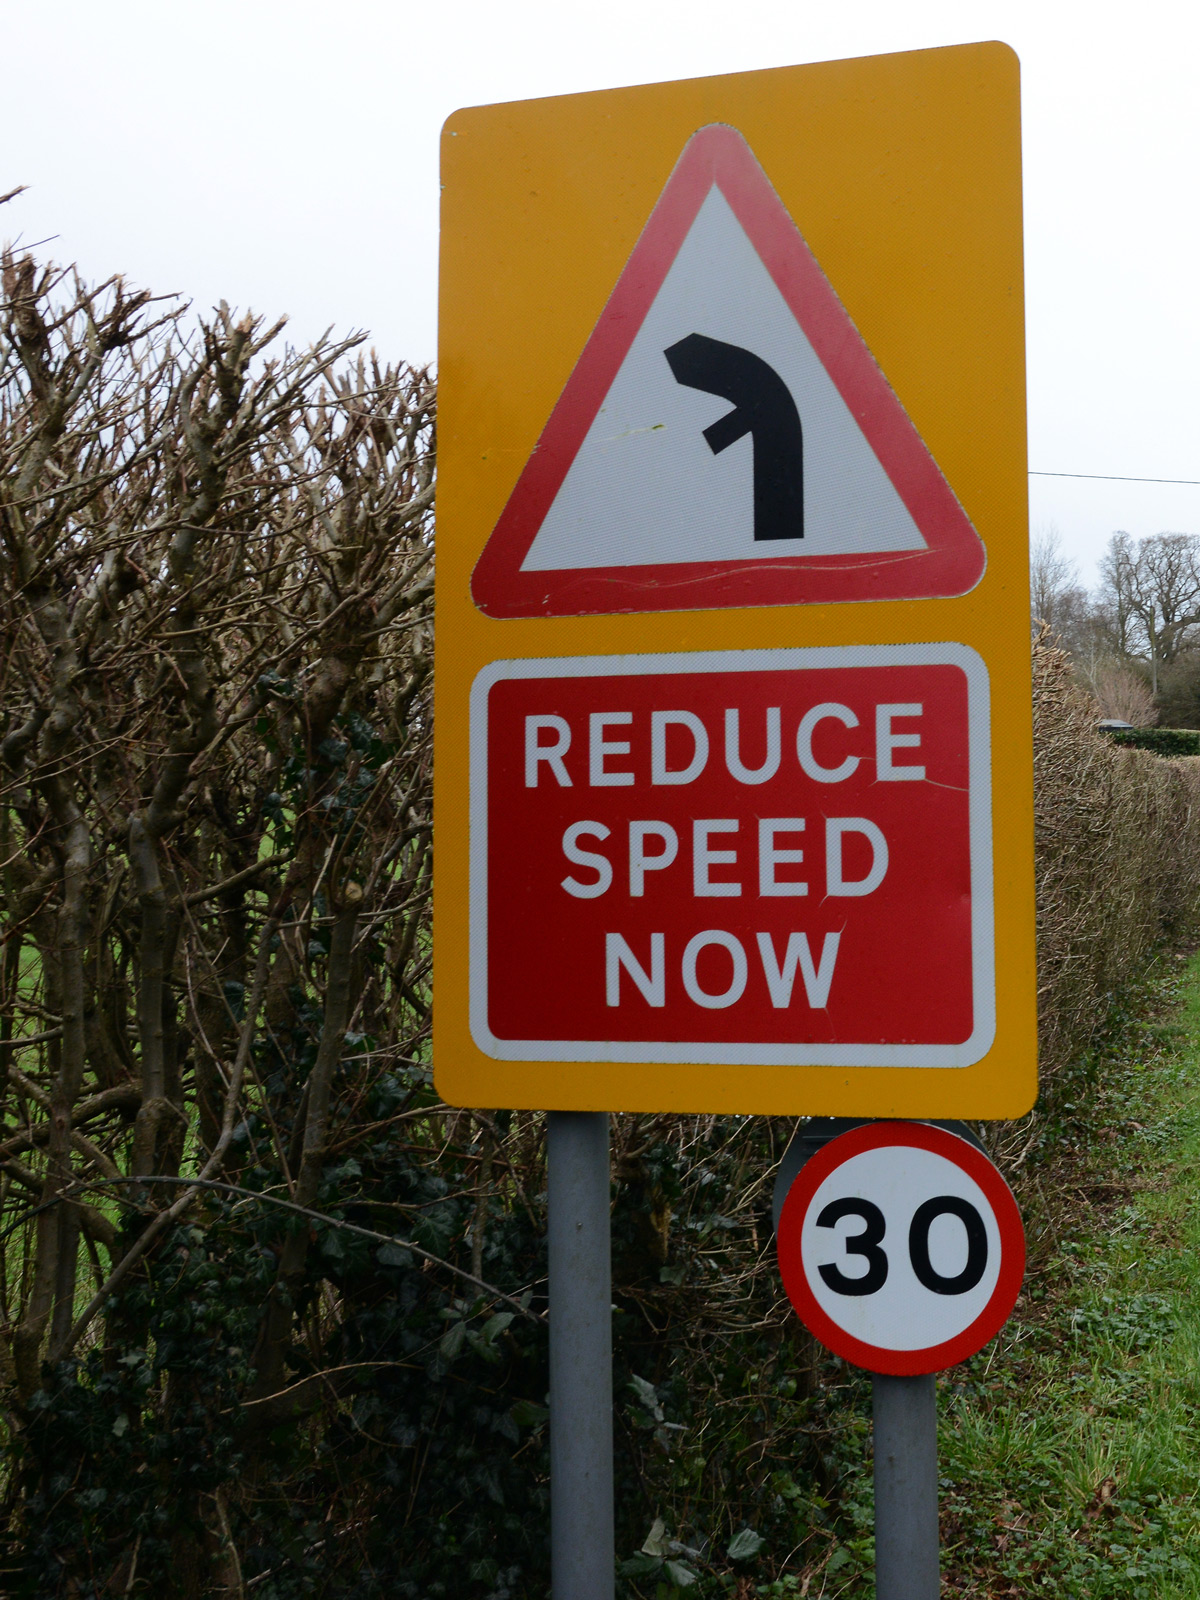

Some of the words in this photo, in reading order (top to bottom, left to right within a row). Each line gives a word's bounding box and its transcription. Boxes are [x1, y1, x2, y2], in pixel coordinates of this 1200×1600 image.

[525, 703, 927, 788] REDUCE
[561, 816, 890, 899] SPEED
[606, 929, 842, 1009] NOW
[816, 1196, 988, 1297] 30
